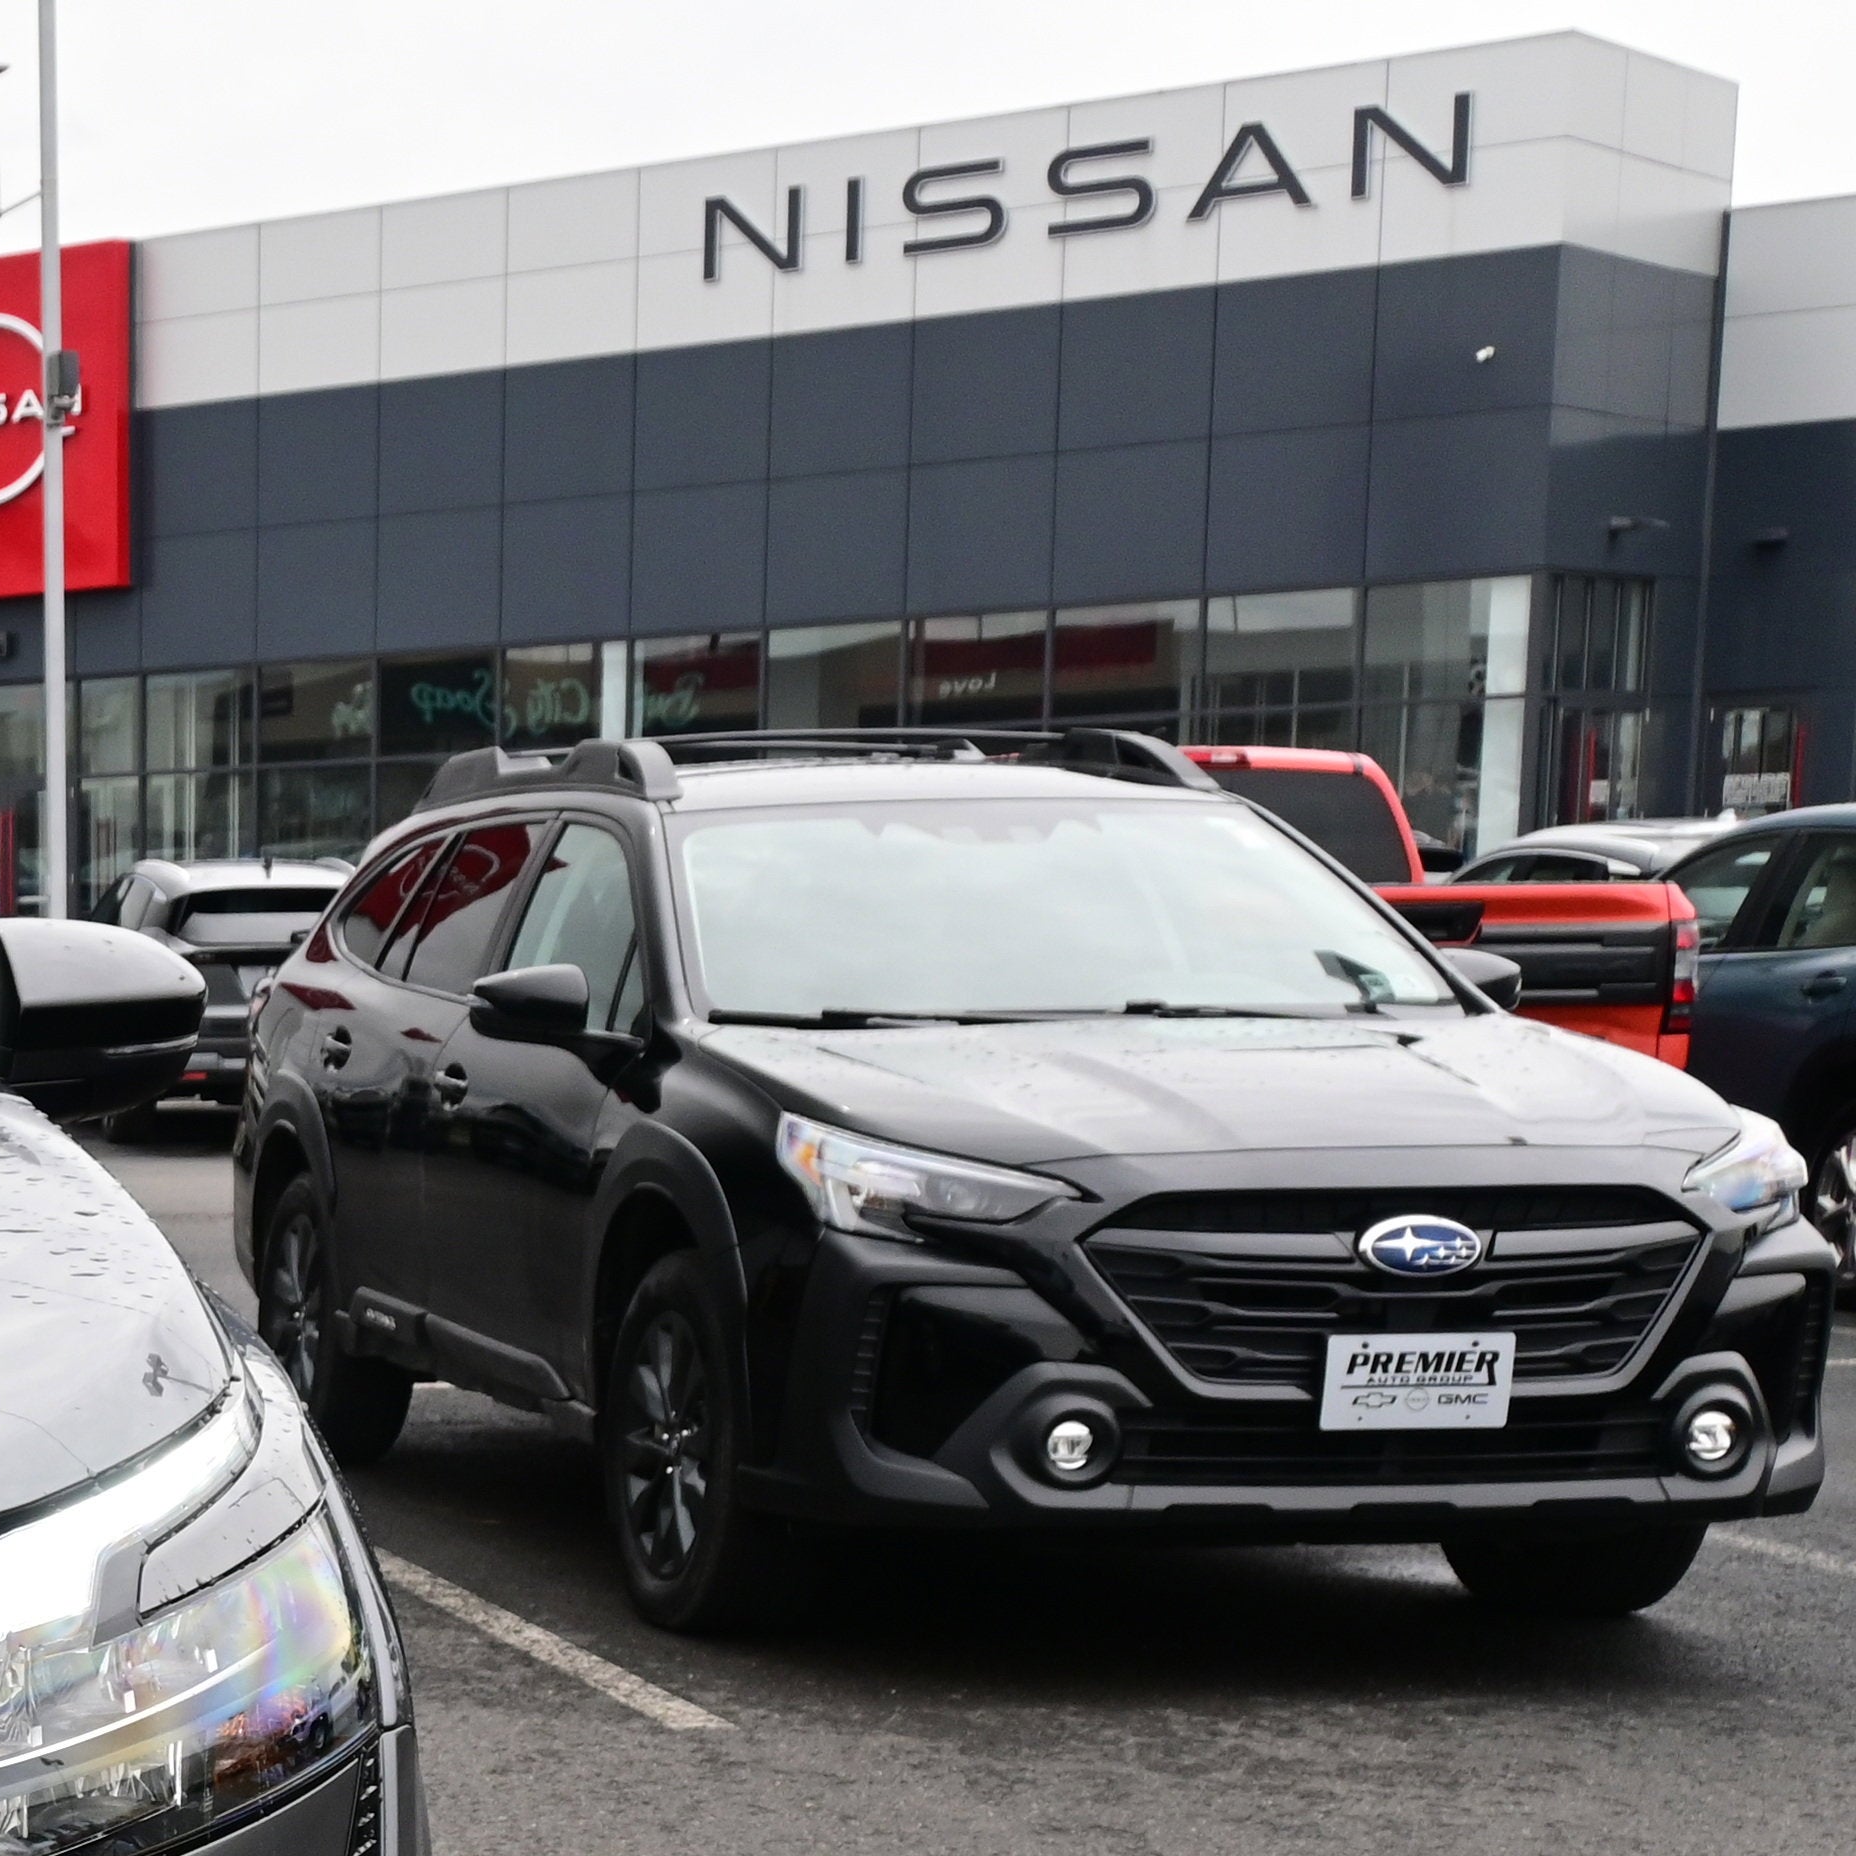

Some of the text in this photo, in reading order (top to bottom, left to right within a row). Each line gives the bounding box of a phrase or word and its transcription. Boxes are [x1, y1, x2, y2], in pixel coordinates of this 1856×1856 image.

[702, 91, 1473, 282] NISSAN
[1346, 1350, 1500, 1387] PREMIER
[1366, 1374, 1474, 1385] AUTO GROUP
[1437, 1392, 1489, 1405] GMC
